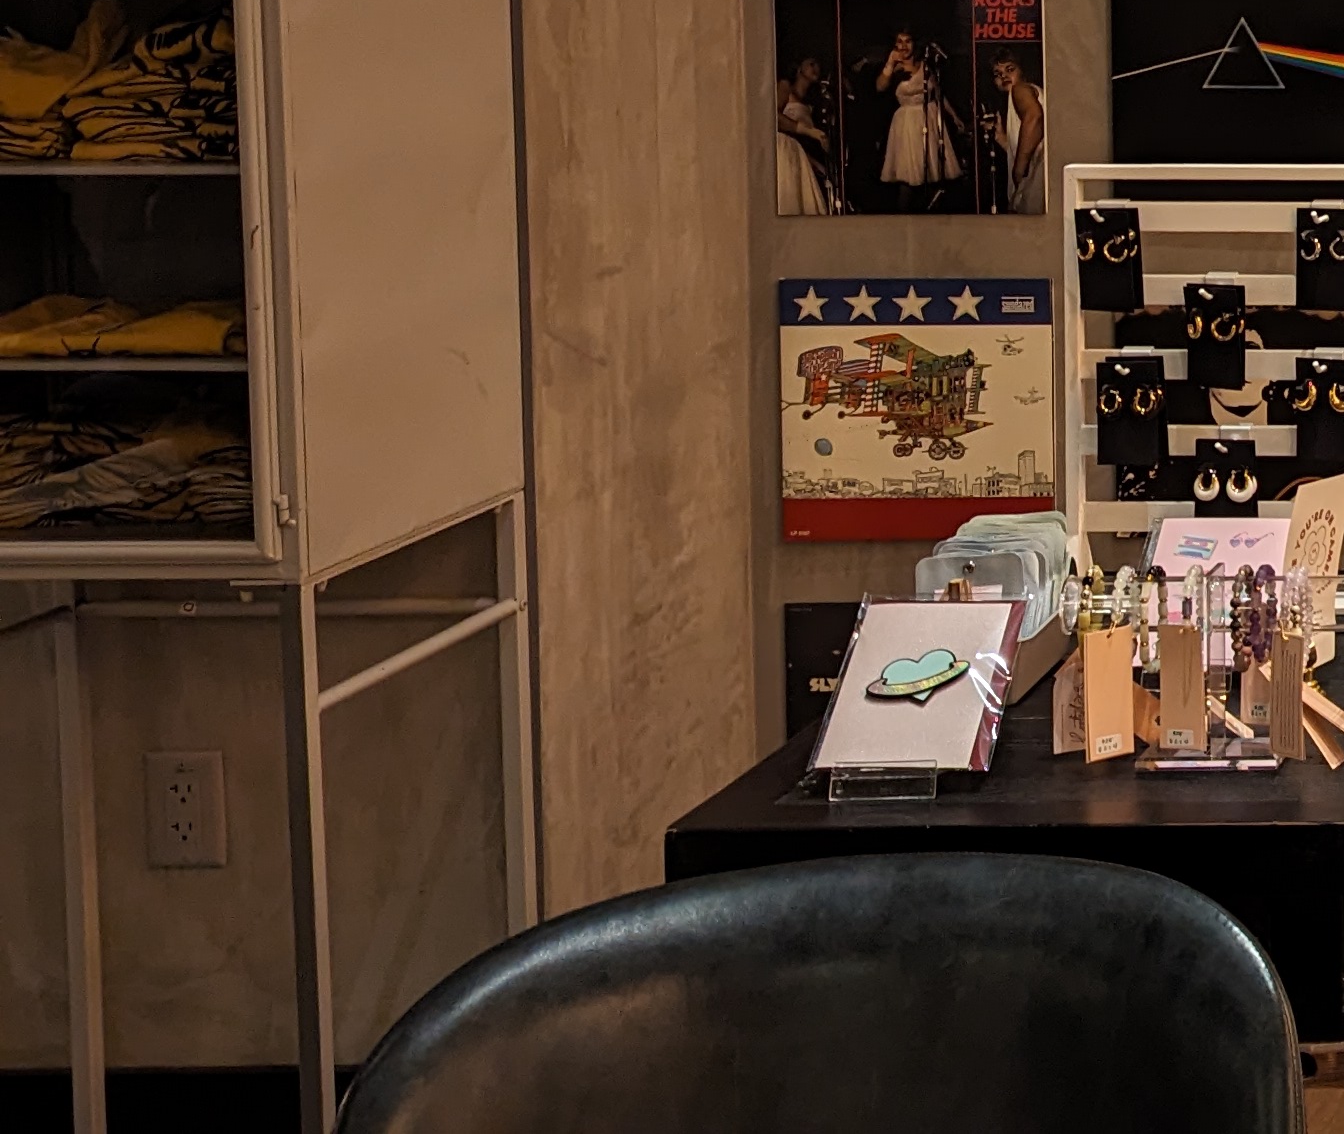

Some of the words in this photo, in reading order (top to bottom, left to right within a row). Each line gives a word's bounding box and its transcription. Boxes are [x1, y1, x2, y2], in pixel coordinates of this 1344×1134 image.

[986, 8, 1017, 23] THE
[974, 23, 1035, 39] HOUSE
[809, 677, 840, 692] SLY
